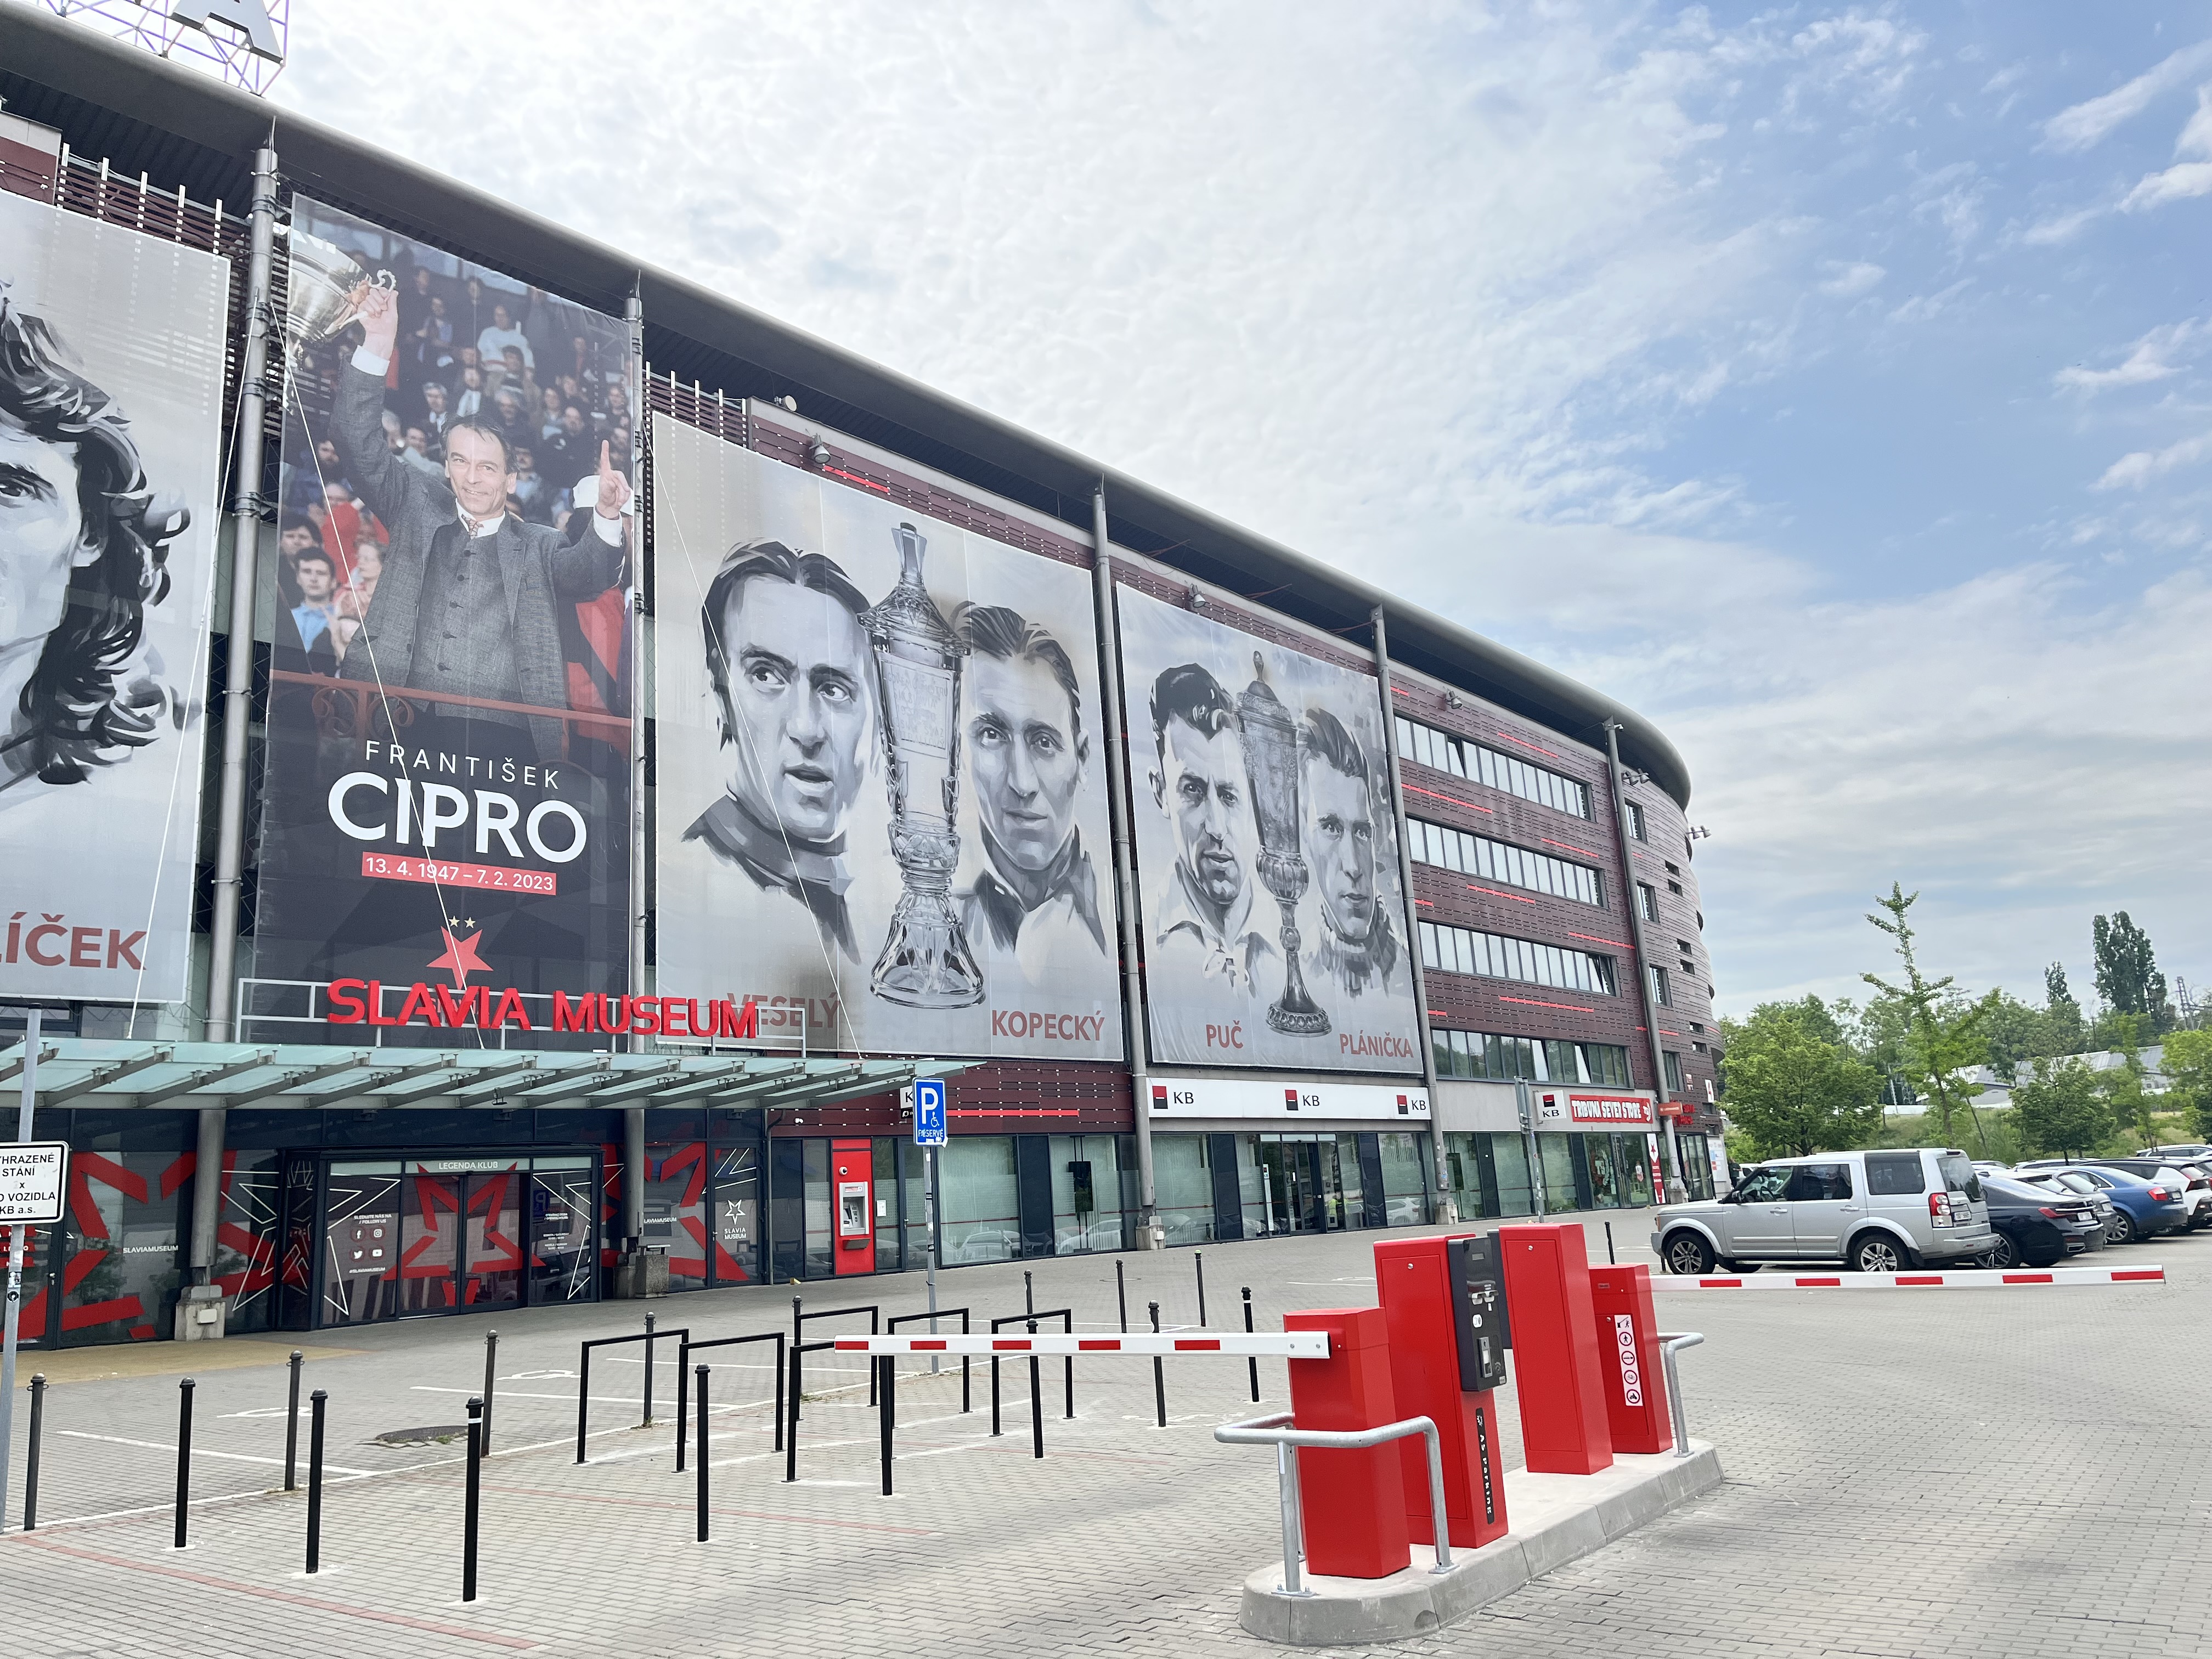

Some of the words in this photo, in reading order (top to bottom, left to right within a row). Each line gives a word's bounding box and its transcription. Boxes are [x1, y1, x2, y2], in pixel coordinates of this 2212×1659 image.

[365, 740, 558, 789] FRANTIŠEK
[328, 771, 587, 863] CIPRO
[366, 857, 391, 874] 13.
[397, 860, 413, 877] 4.
[417, 862, 459, 881] 1947
[477, 870, 489, 885] 7.
[493, 871, 508, 887] 2.
[512, 874, 554, 891] 2023
[0, 911, 147, 970] ÍČEK
[327, 978, 532, 1030] SLAVIA
[552, 990, 756, 1039] MUSEUM
[992, 1010, 1105, 1041] KOPECKÝ
[1206, 1020, 1244, 1049] PUČ
[1339, 1030, 1414, 1058] PLÁNIČKA
[905, 1090, 913, 1103] K
[921, 1087, 939, 1124] P
[1173, 1092, 1194, 1104] KB
[1302, 1095, 1320, 1106] KB
[1412, 1100, 1426, 1110] KB
[1543, 1109, 1560, 1118] KB
[1571, 1100, 1601, 1118] TRIBUNA
[1601, 1101, 1622, 1119] SEVER
[1622, 1102, 1641, 1119] STORE
[0, 1152, 54, 1164] HRAZENÉ
[2, 1165, 35, 1177] STÁNÍ
[8, 1192, 55, 1201] VOZIDLA
[123, 1245, 178, 1254] SLAVIAMUSEUM
